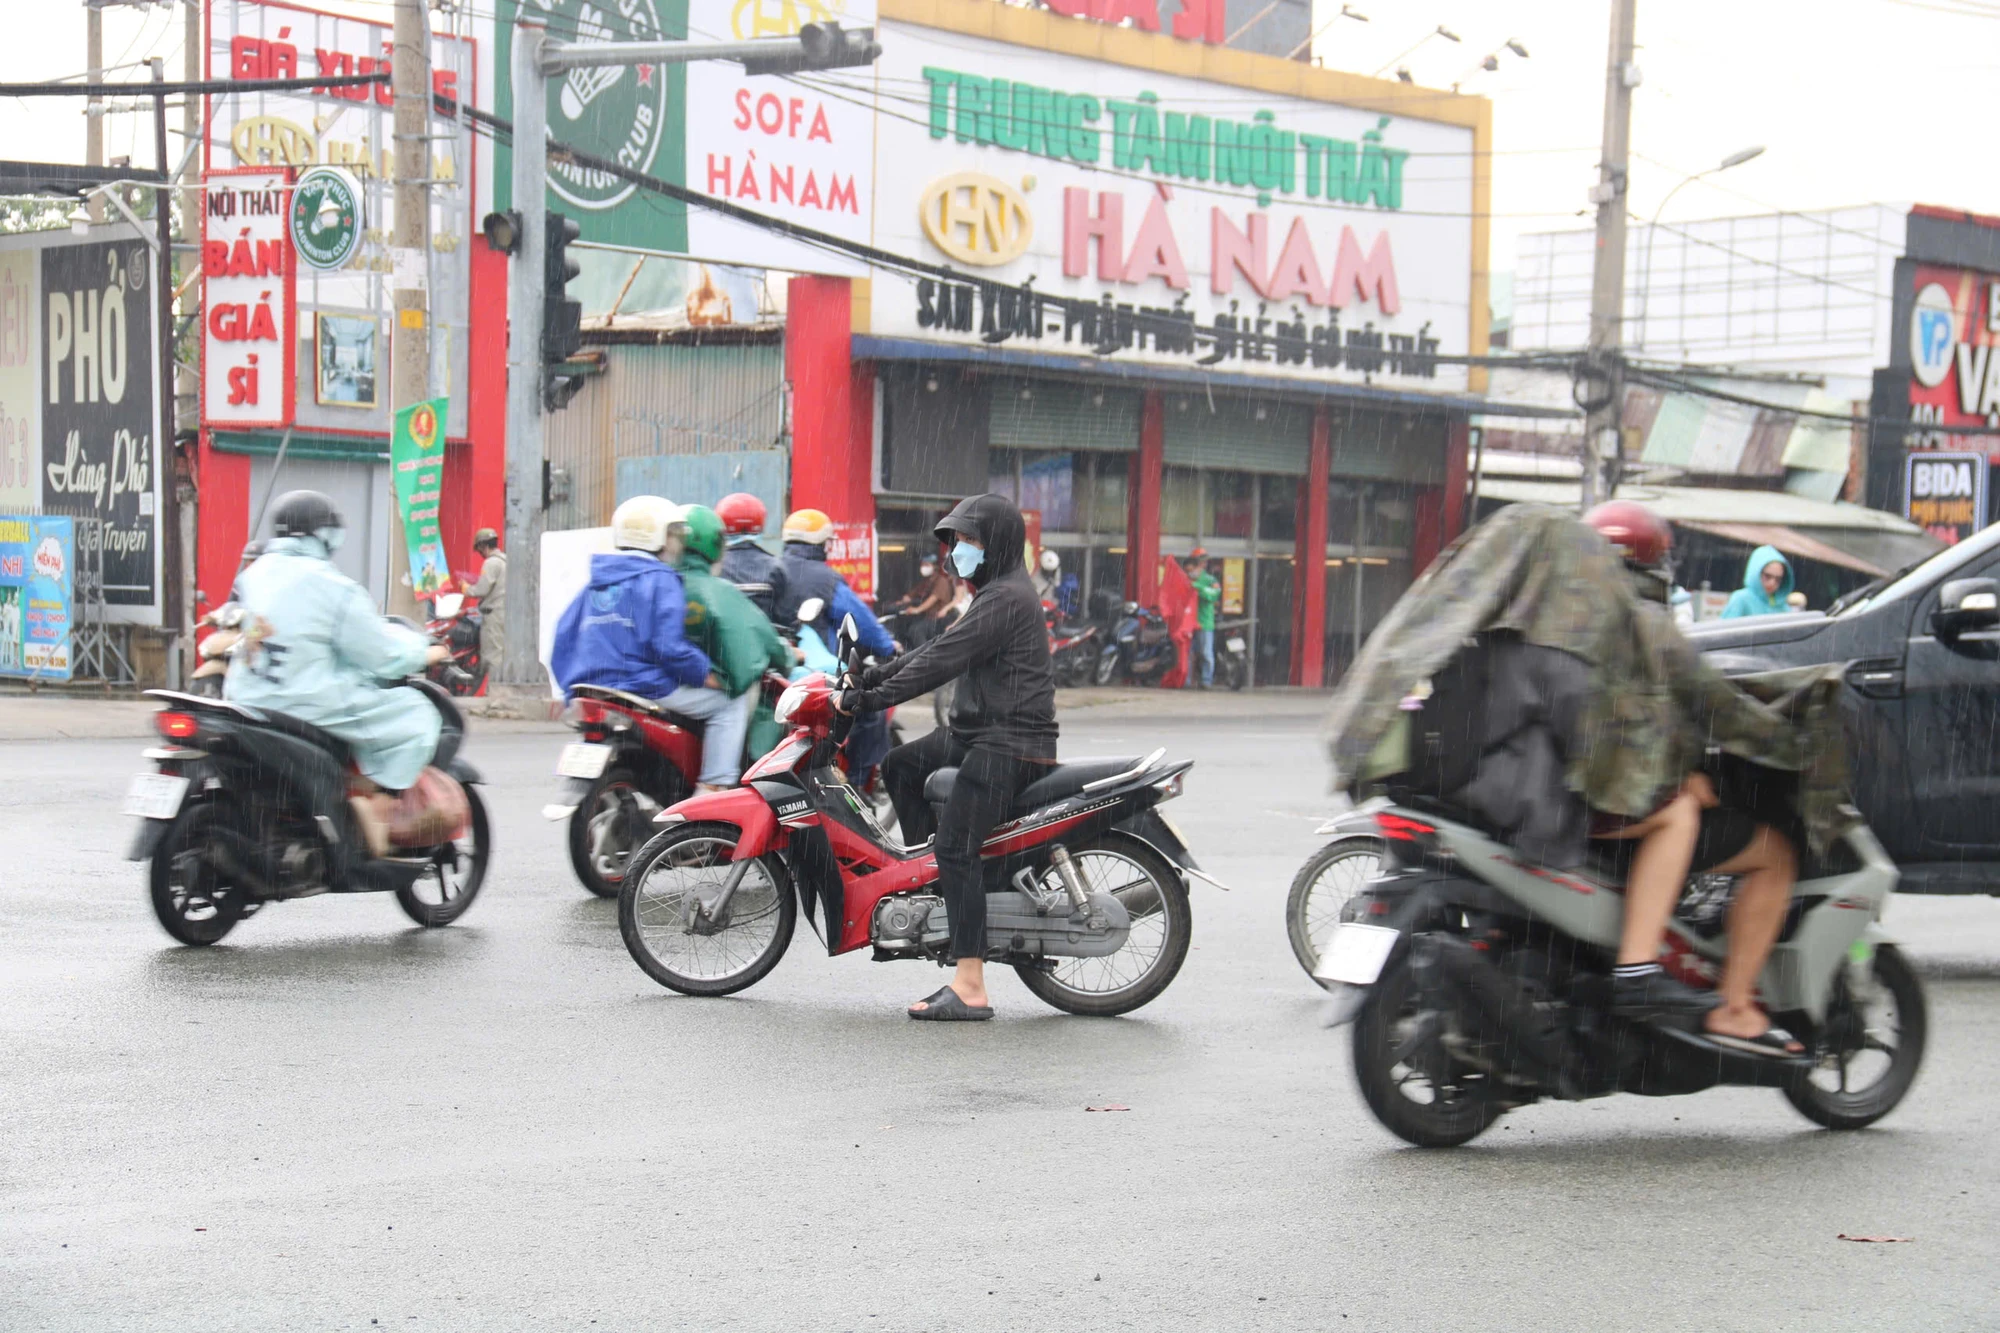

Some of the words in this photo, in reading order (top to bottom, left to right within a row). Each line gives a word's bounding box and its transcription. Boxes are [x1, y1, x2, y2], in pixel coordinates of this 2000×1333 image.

[231, 27, 297, 82] GIÁ
[618, 103, 653, 169] CLUB
[735, 88, 833, 144] SOFA
[923, 66, 1099, 162] TRUNG
[1106, 91, 1211, 181] TÂM
[1215, 110, 1295, 207] NỘI
[1300, 117, 1408, 211] THẤT
[208, 185, 236, 220] NỘI
[240, 180, 282, 216] THẤT
[327, 179, 351, 210] PHÚC
[708, 150, 761, 202] HÀ
[770, 164, 860, 216] NAM
[206, 228, 282, 277] BÁN
[296, 221, 333, 261] BADMINTON
[333, 231, 351, 257] CLUB
[1063, 182, 1190, 289] HÀ
[1211, 206, 1399, 315] NAM
[49, 249, 125, 404] PHỞ
[208, 291, 278, 342] GIÁ
[227, 354, 259, 405] SỈ
[47, 429, 107, 509] Hàng
[108, 428, 149, 511] Phố
[1914, 462, 1972, 496] BIDA
[103, 515, 148, 560] Truyền
[1, 555, 23, 577] NHI
[777, 800, 808, 815] YAMAHA
